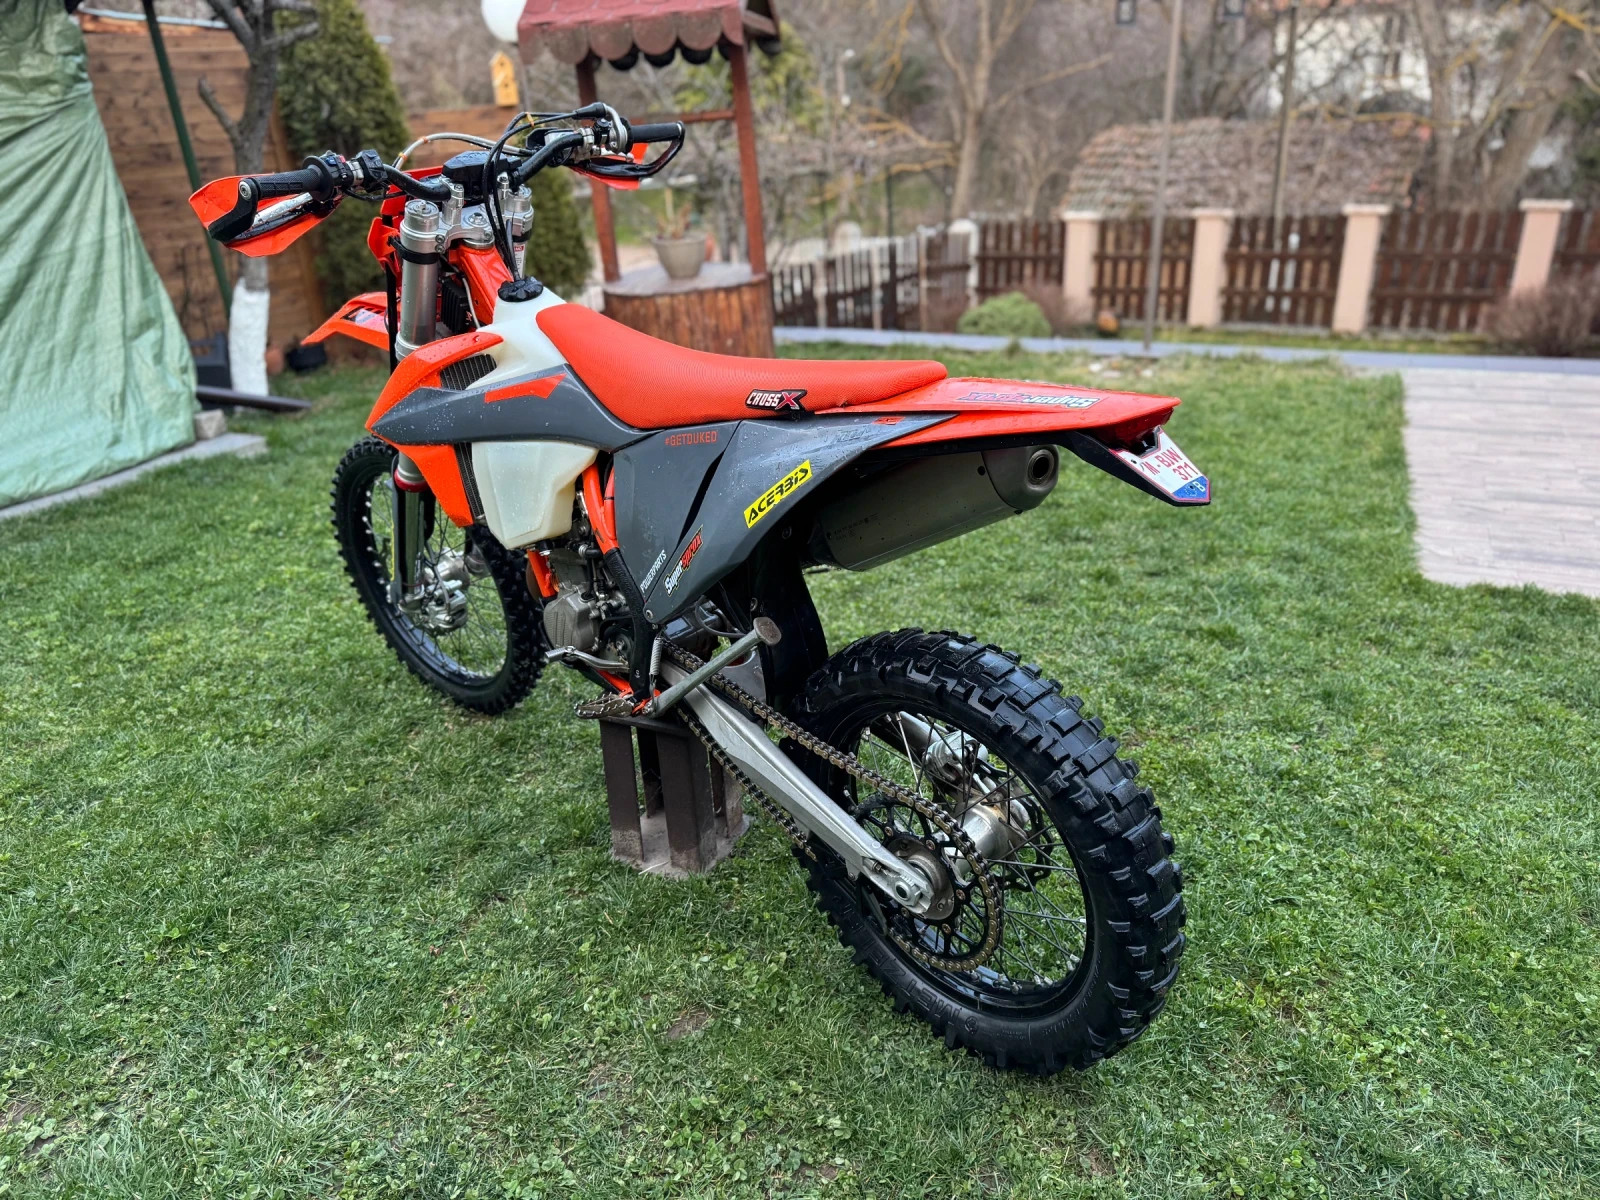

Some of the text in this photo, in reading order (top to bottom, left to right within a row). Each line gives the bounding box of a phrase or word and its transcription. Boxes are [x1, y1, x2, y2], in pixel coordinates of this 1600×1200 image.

[664, 431, 717, 447] #GETDUKED
[1173, 461, 1199, 481] 371
[639, 549, 667, 593] POWERPARTS
